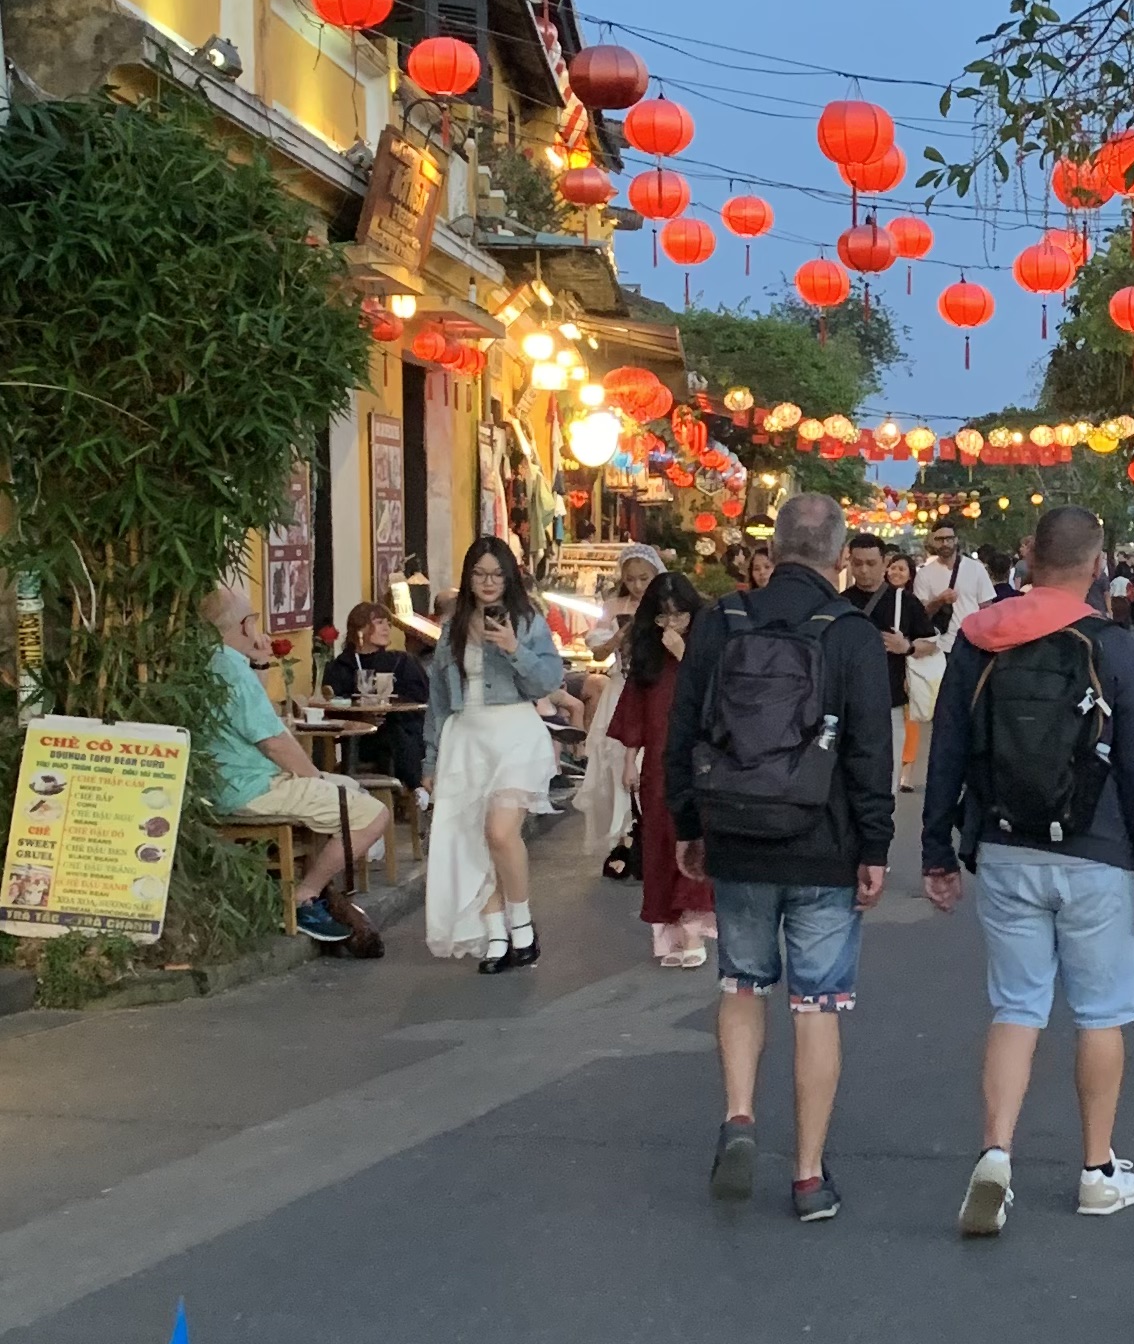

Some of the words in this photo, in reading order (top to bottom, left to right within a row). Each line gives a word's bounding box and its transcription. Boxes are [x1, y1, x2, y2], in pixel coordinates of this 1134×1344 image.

[40, 735, 80, 749] CHÈ
[86, 739, 113, 752] CÔ
[119, 743, 180, 759] XUÂN
[90, 753, 111, 763] TOFU
[17, 837, 57, 849] SWEET
[15, 849, 54, 861] GRUEL
[106, 918, 153, 931] CHANH
